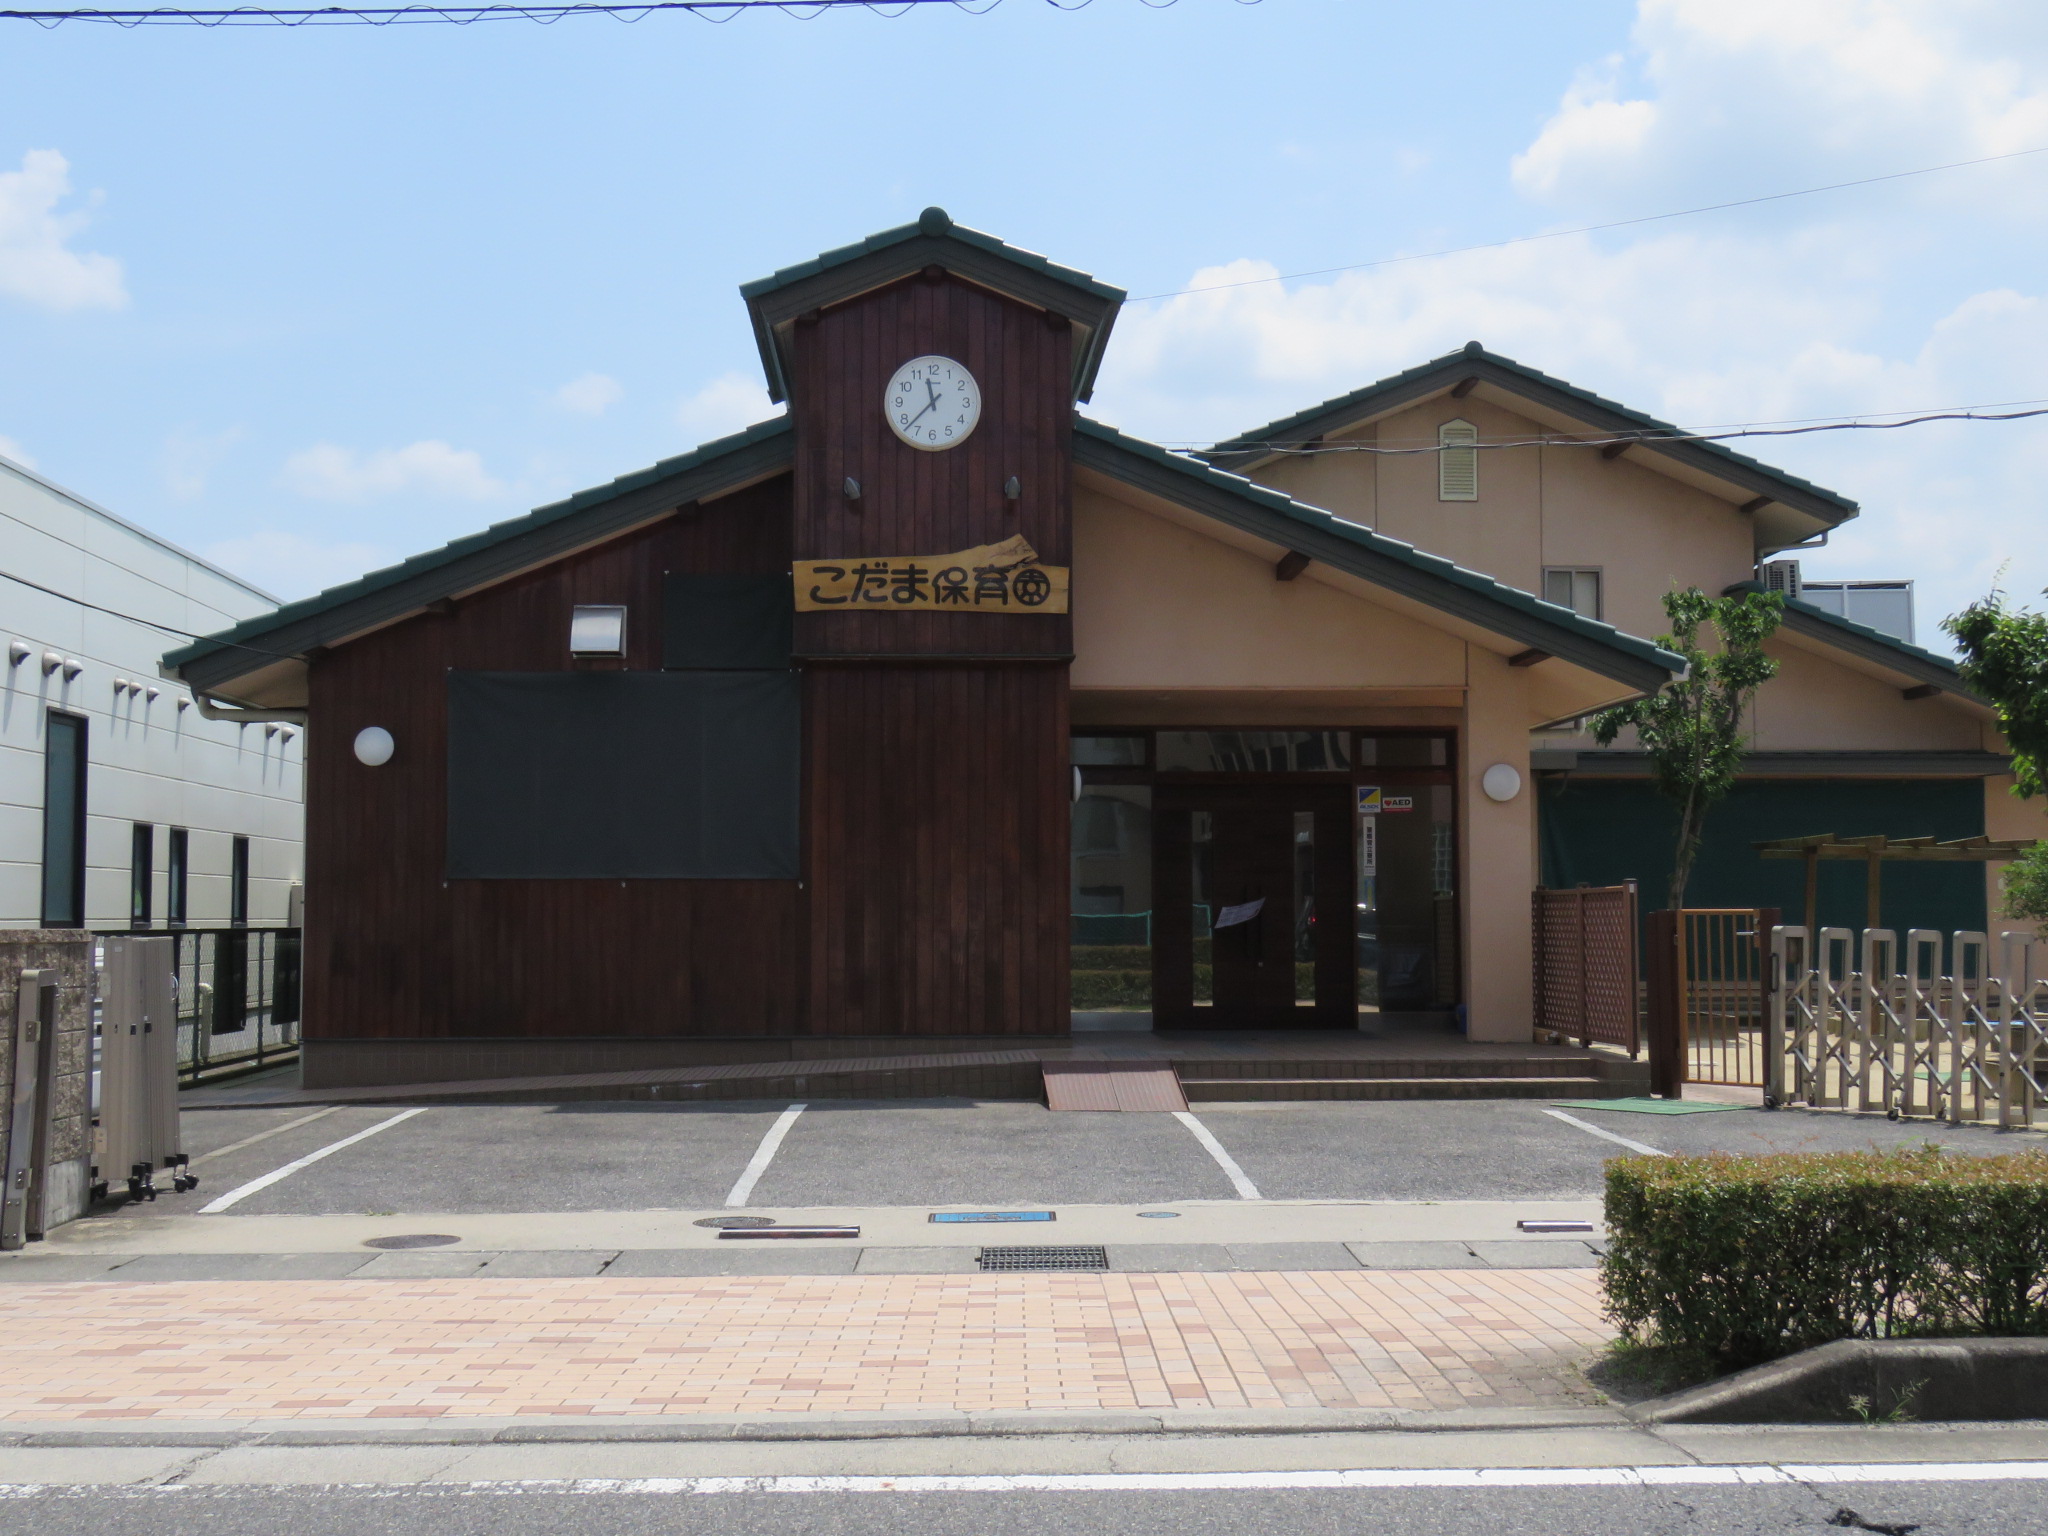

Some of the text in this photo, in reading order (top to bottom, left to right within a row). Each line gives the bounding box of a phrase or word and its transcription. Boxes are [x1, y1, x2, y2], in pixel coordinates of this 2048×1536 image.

[911, 369, 921, 380] 11
[928, 364, 939, 375] 12
[900, 381, 912, 392] 10
[957, 380, 965, 391] 2
[895, 396, 903, 408] 9
[962, 397, 970, 408] 3
[900, 413, 908, 425] 8
[957, 414, 965, 424] 4
[914, 425, 921, 436] 7
[928, 429, 936, 440] 6
[944, 425, 952, 437] 5
[810, 561, 1050, 607] こだま保育園
